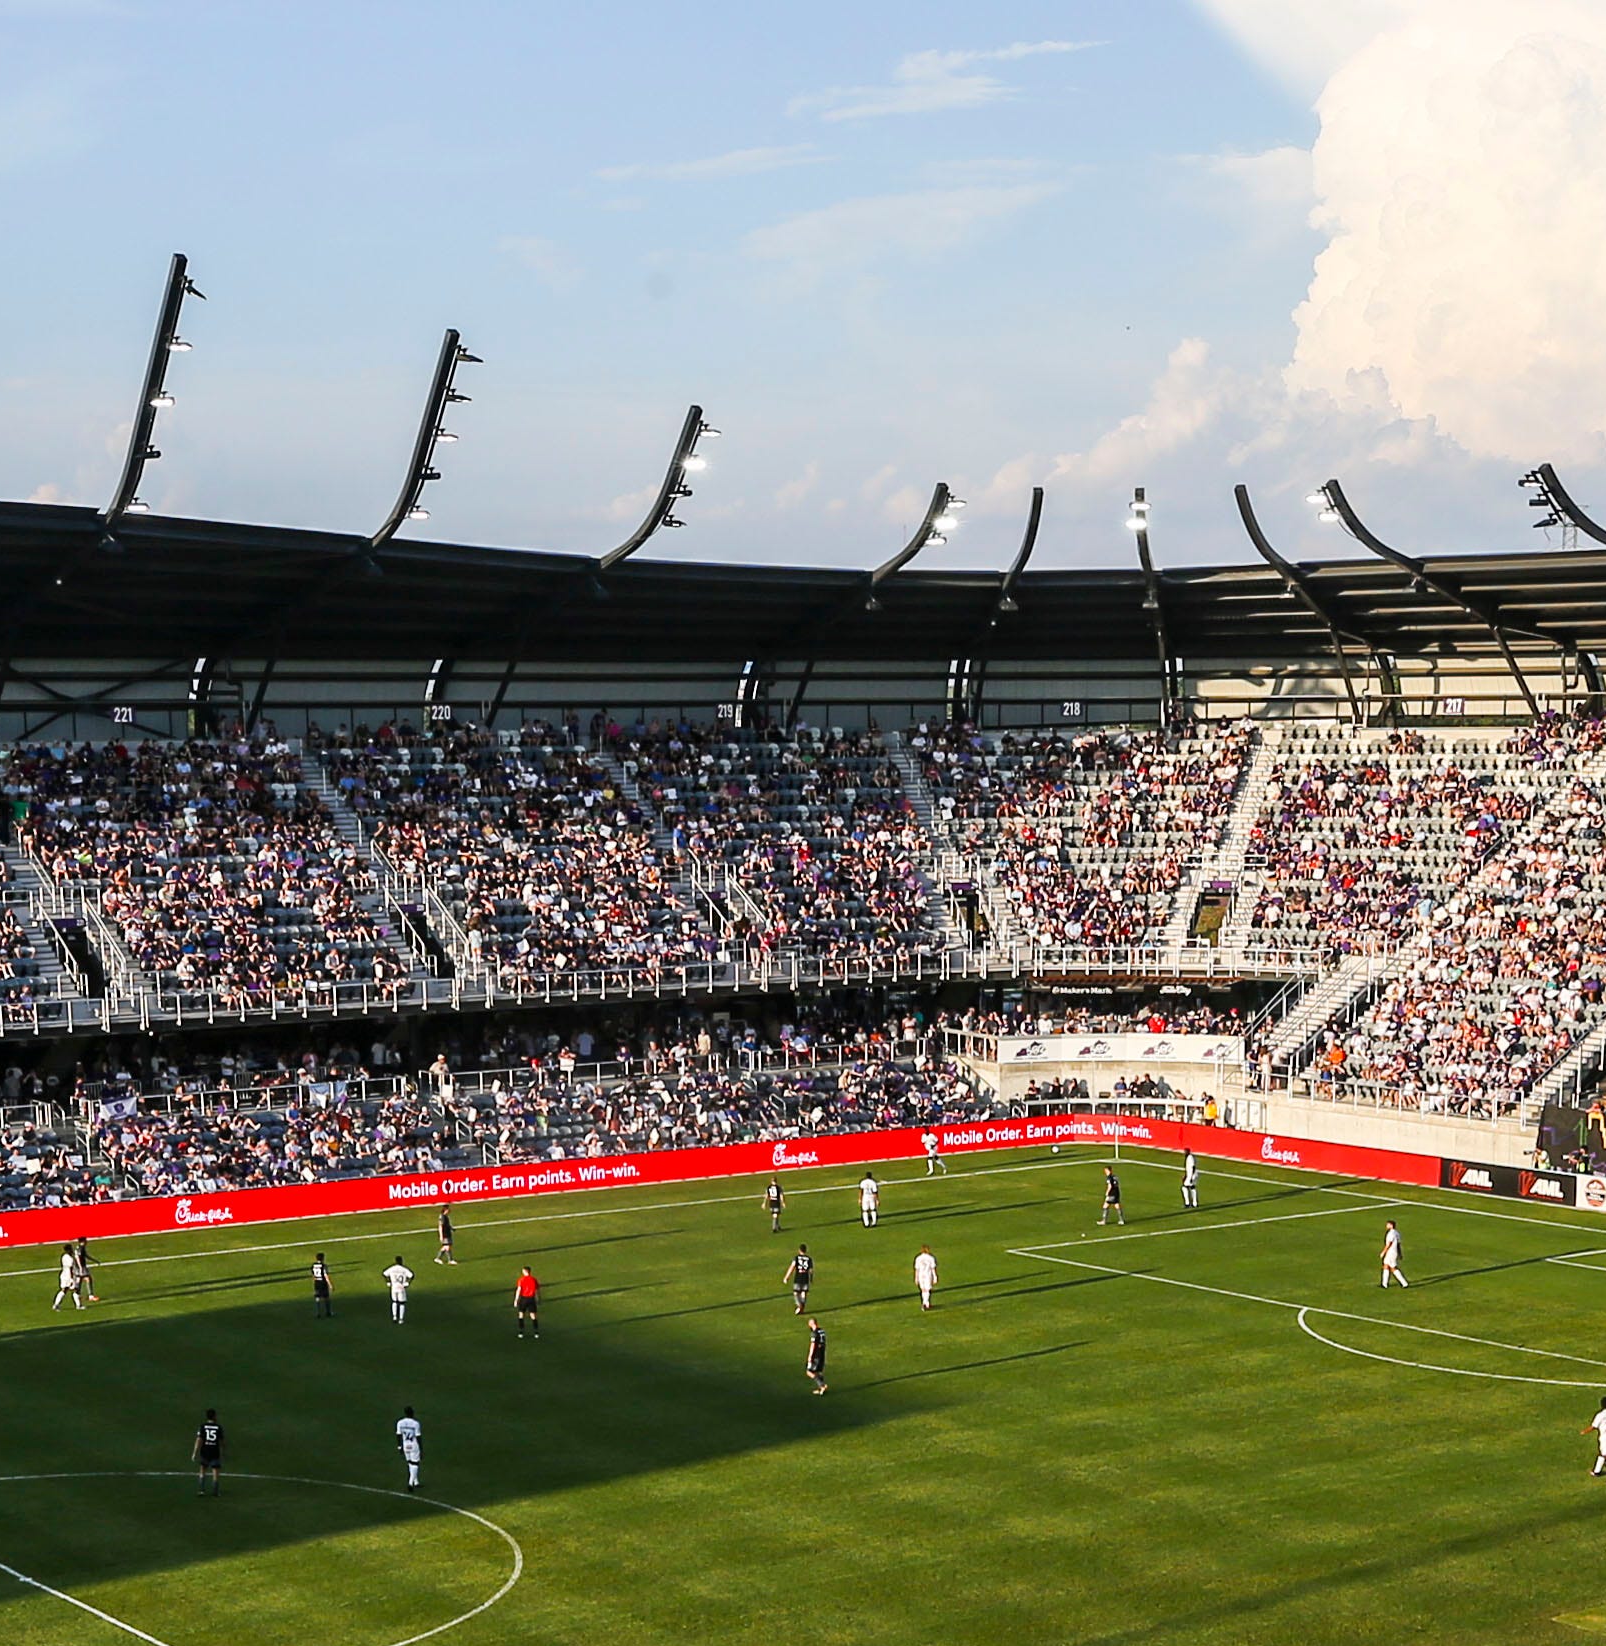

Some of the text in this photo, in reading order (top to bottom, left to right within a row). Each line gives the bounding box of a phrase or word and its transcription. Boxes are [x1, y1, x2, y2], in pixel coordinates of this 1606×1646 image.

[432, 705, 451, 720] 220
[717, 704, 733, 718] 219
[1063, 702, 1080, 716] 218
[1446, 698, 1462, 713] 217
[114, 707, 133, 723] 221
[942, 1129, 982, 1146] Mobile
[985, 1126, 1023, 1143] Order.
[1026, 1123, 1052, 1139] Earn
[1054, 1121, 1097, 1138] points.
[389, 1162, 639, 1199] Mobile Order. Earn points. Win-win.
[1460, 1168, 1493, 1188] AML
[1530, 1177, 1564, 1198] AML
[205, 1429, 217, 1441] 15
